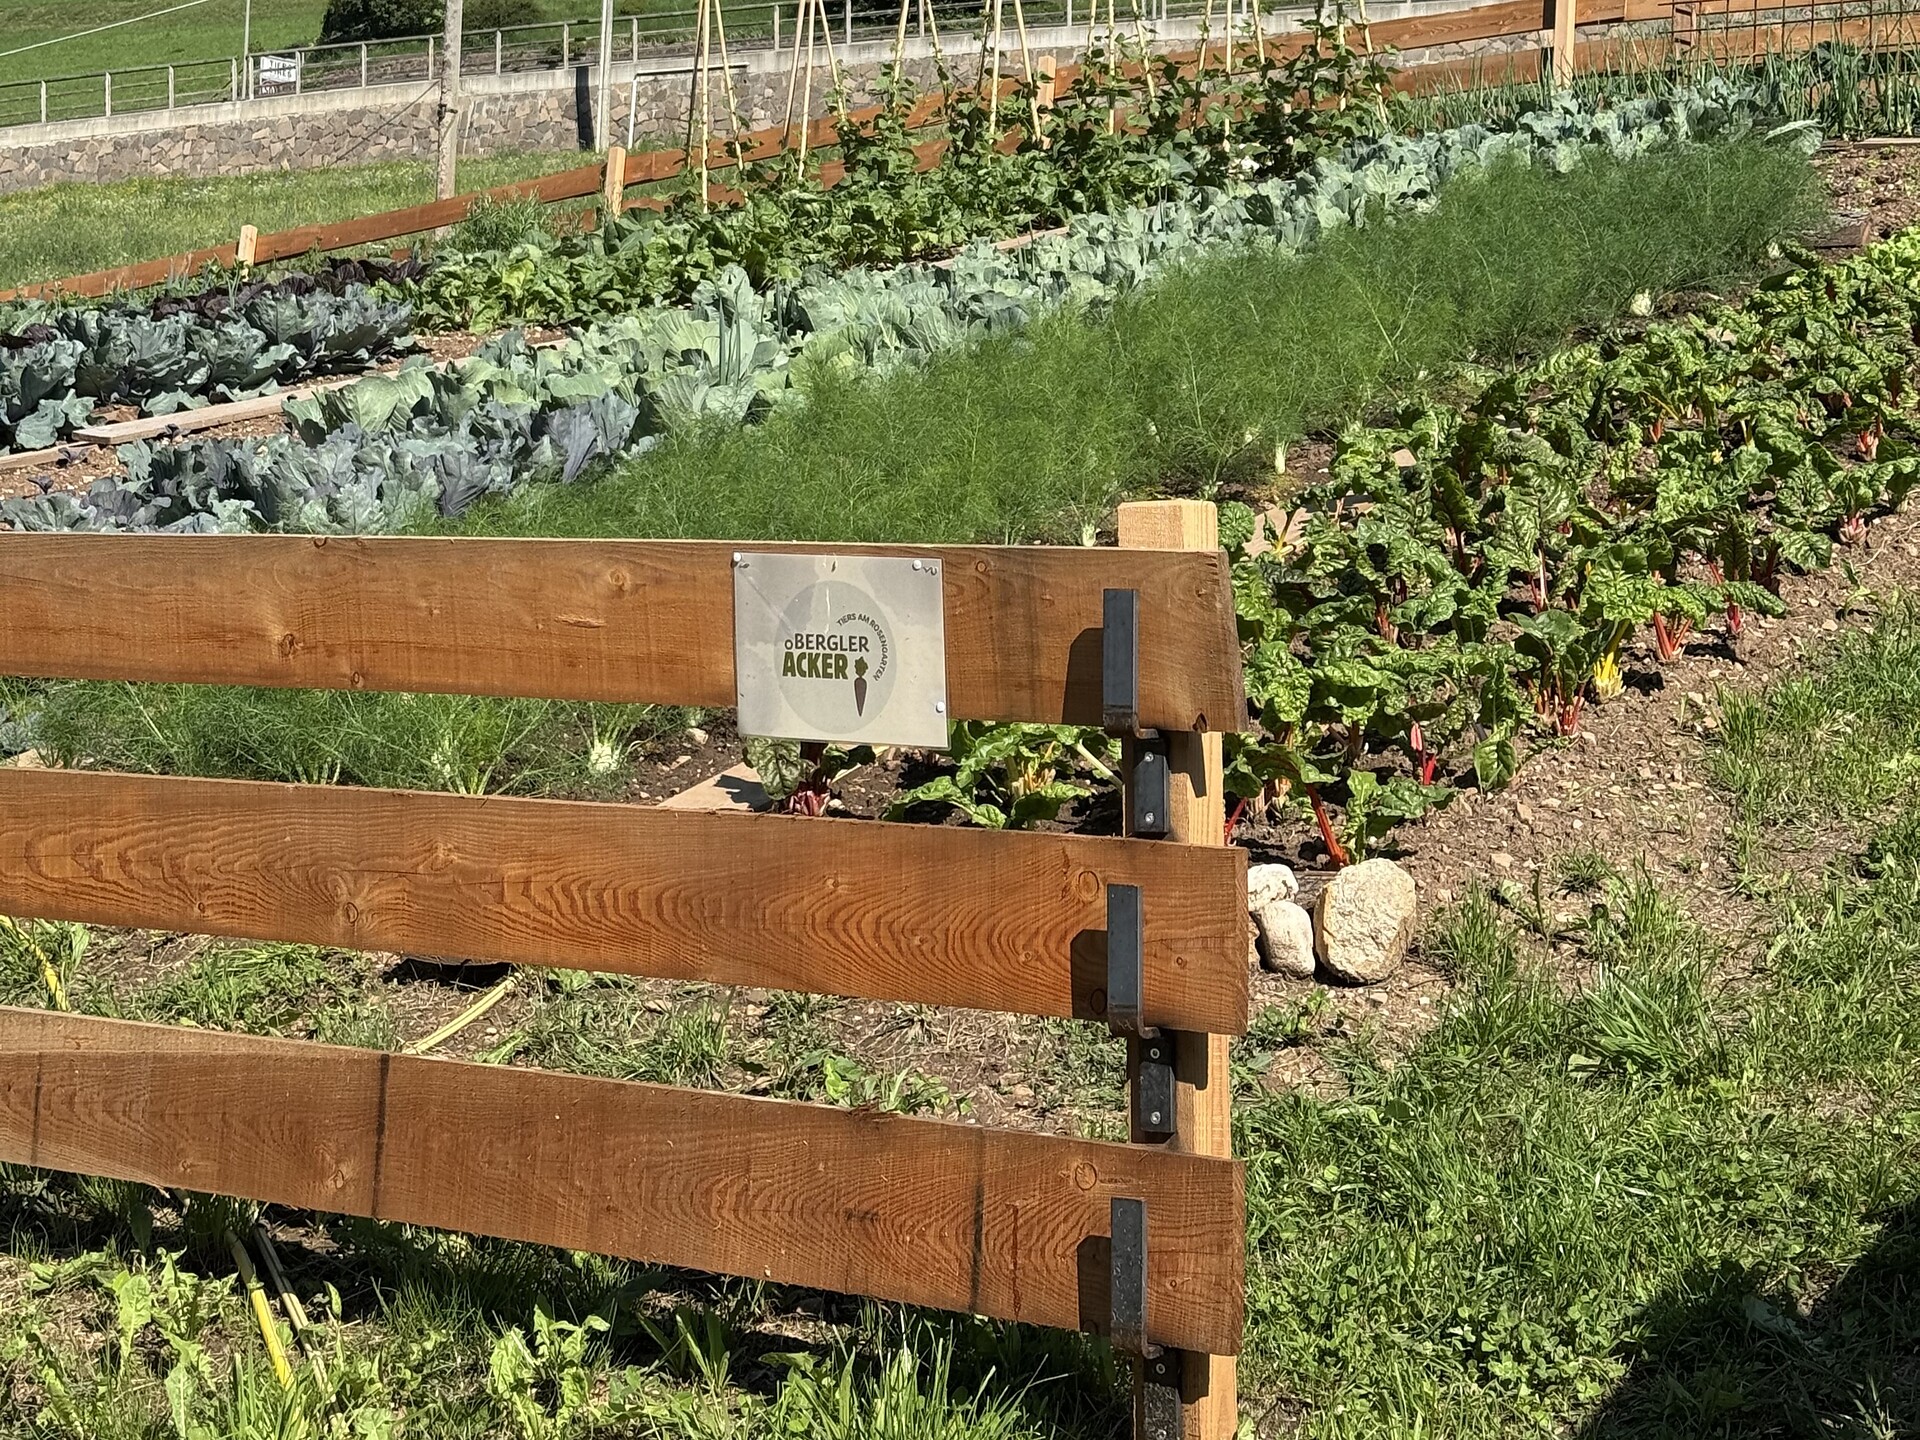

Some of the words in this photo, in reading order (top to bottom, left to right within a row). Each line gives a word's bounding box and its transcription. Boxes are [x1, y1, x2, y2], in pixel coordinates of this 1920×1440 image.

[782, 651, 849, 680] ACKER
[836, 613, 856, 627] TIERS
[858, 613, 870, 624] AM
[869, 619, 889, 682] ROSENGARTEN
